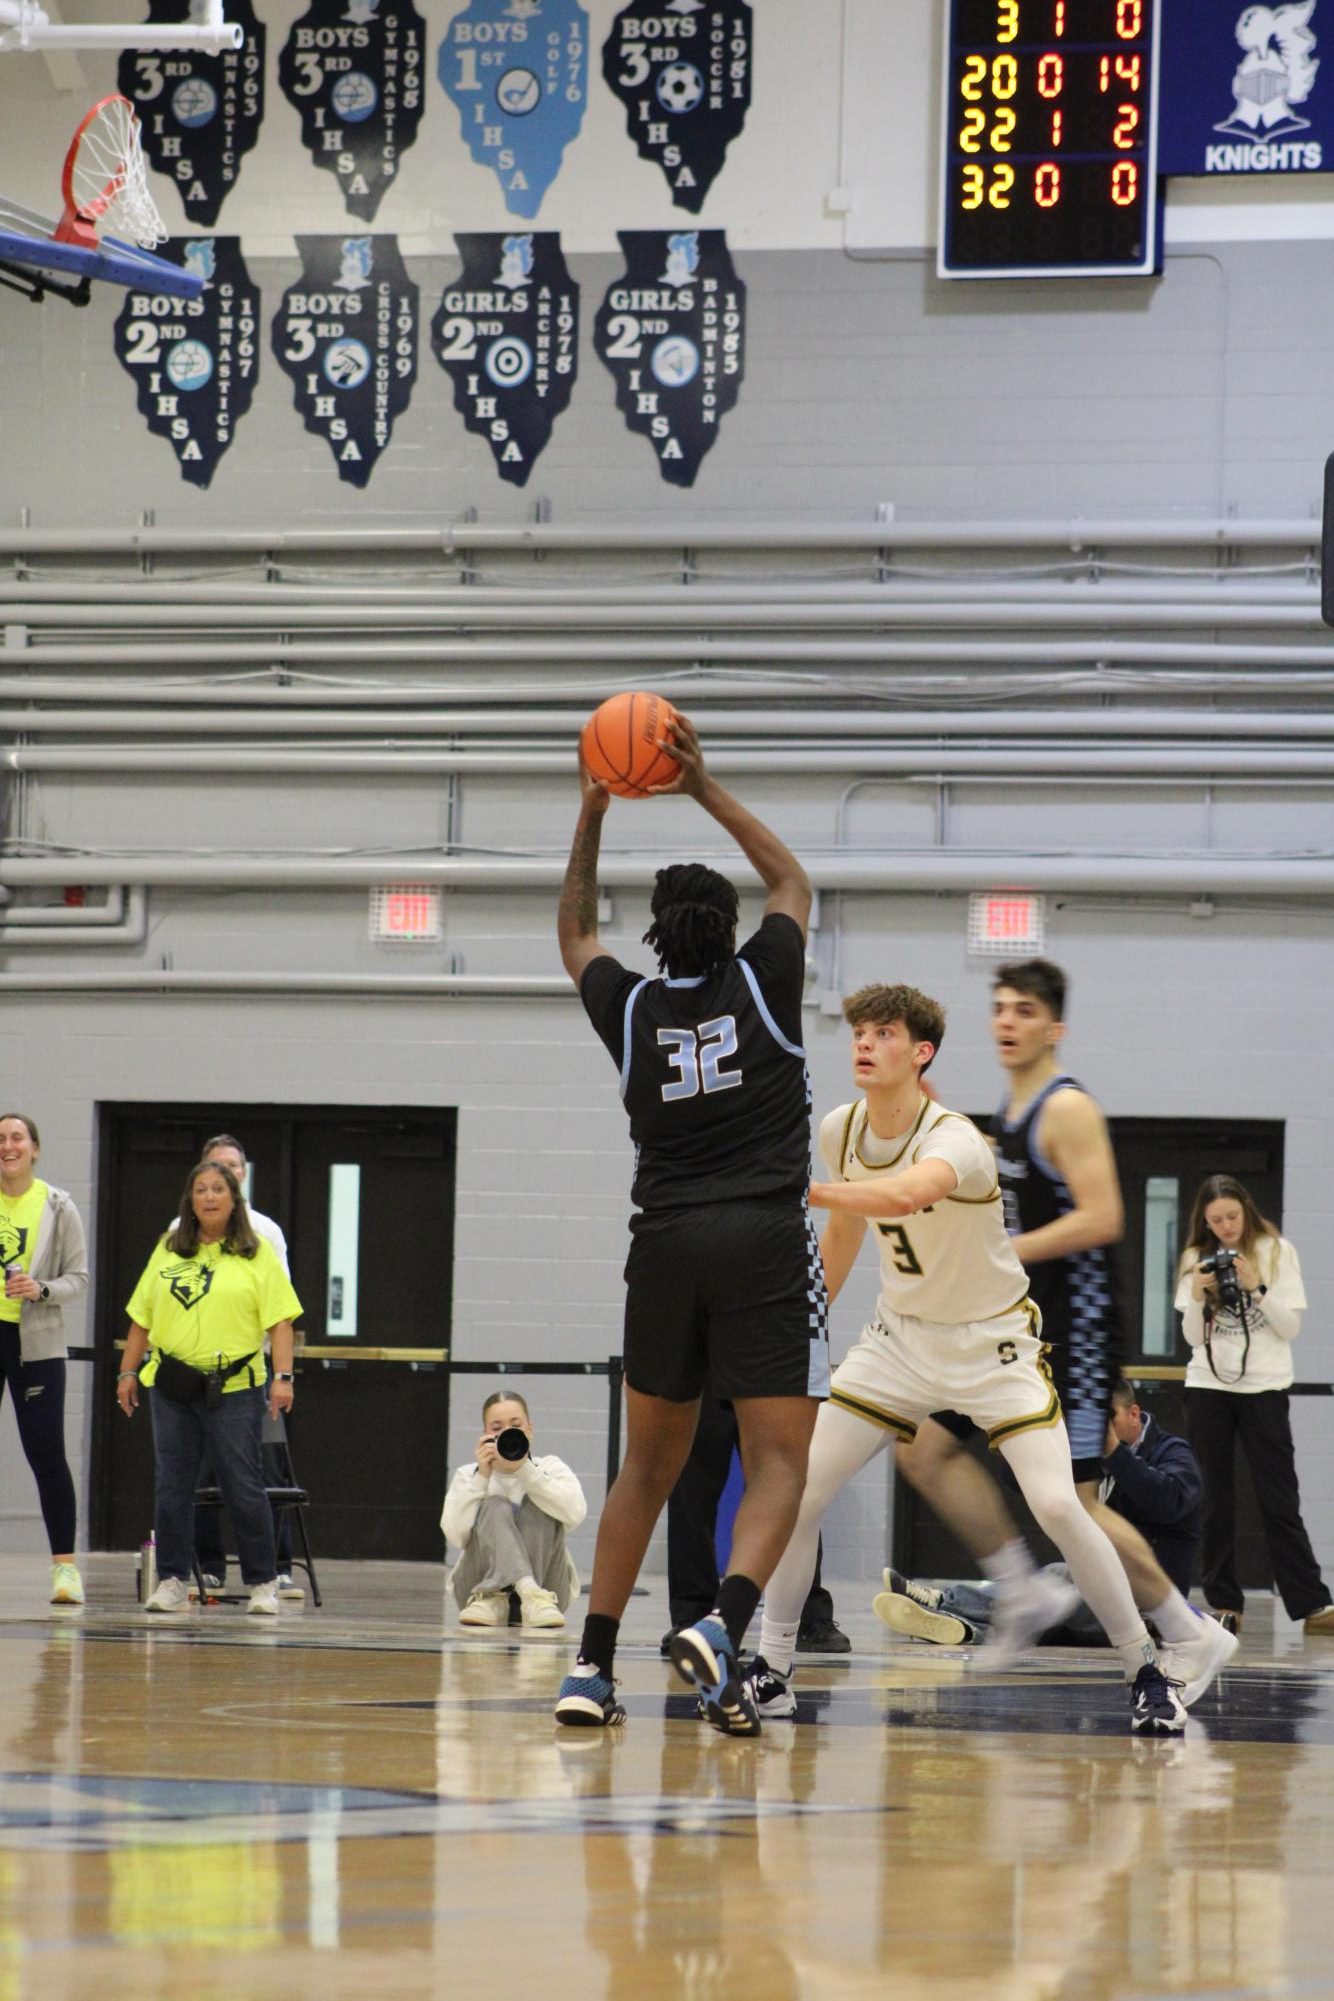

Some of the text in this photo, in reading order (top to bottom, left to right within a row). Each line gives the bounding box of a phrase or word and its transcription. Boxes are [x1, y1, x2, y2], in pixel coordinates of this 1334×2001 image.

[296, 28, 369, 49] BOYS
[453, 22, 528, 43] BOYS
[621, 17, 697, 39] BOYS
[730, 19, 746, 99] 1981
[996, 0, 1142, 43] 3 1 0
[244, 37, 260, 117] 1963
[383, 15, 398, 176] GYMNASTICS
[403, 30, 420, 109] 1968
[546, 31, 560, 95] GOLF
[566, 22, 583, 102] 1976
[709, 13, 724, 109] SOCCER
[960, 52, 1141, 100] 20 0 14
[223, 49, 239, 181] MNASTICS
[959, 103, 1139, 153] 22 1 2
[960, 160, 1138, 210] 32 0 0
[1205, 142, 1322, 172] KNIGHTS
[131, 295, 205, 317] BOYS
[238, 298, 255, 378] 1967
[288, 293, 363, 315] BOYS
[395, 298, 414, 379] 1969
[444, 291, 529, 313] GIRLS
[555, 296, 574, 374] 1978
[609, 289, 695, 312] GIRLS
[723, 294, 741, 374] 1985
[217, 282, 234, 443] GYMNASTICS
[375, 282, 390, 447] CROSS COUNTRY
[536, 286, 550, 397] ARCHERY
[702, 278, 717, 424] BADMINTON
[657, 1015, 743, 1102] 32
[877, 1221, 925, 1277] 3
